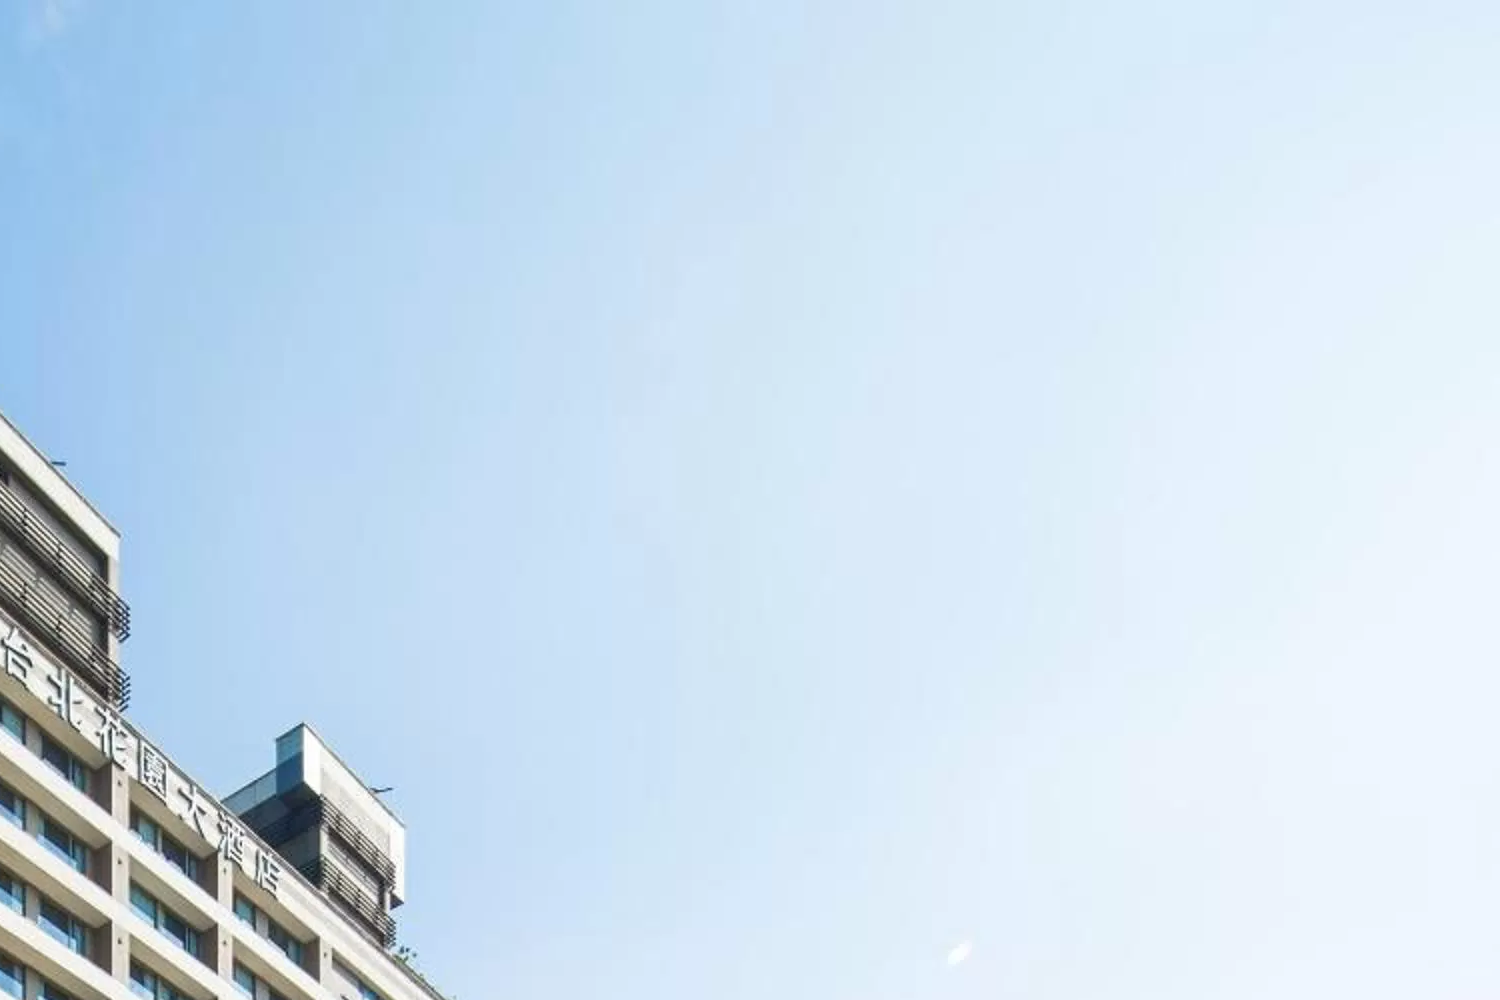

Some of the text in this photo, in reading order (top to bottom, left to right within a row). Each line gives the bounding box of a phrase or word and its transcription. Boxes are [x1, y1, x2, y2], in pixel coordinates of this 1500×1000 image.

[1, 628, 281, 897] 台北花園大酒店
